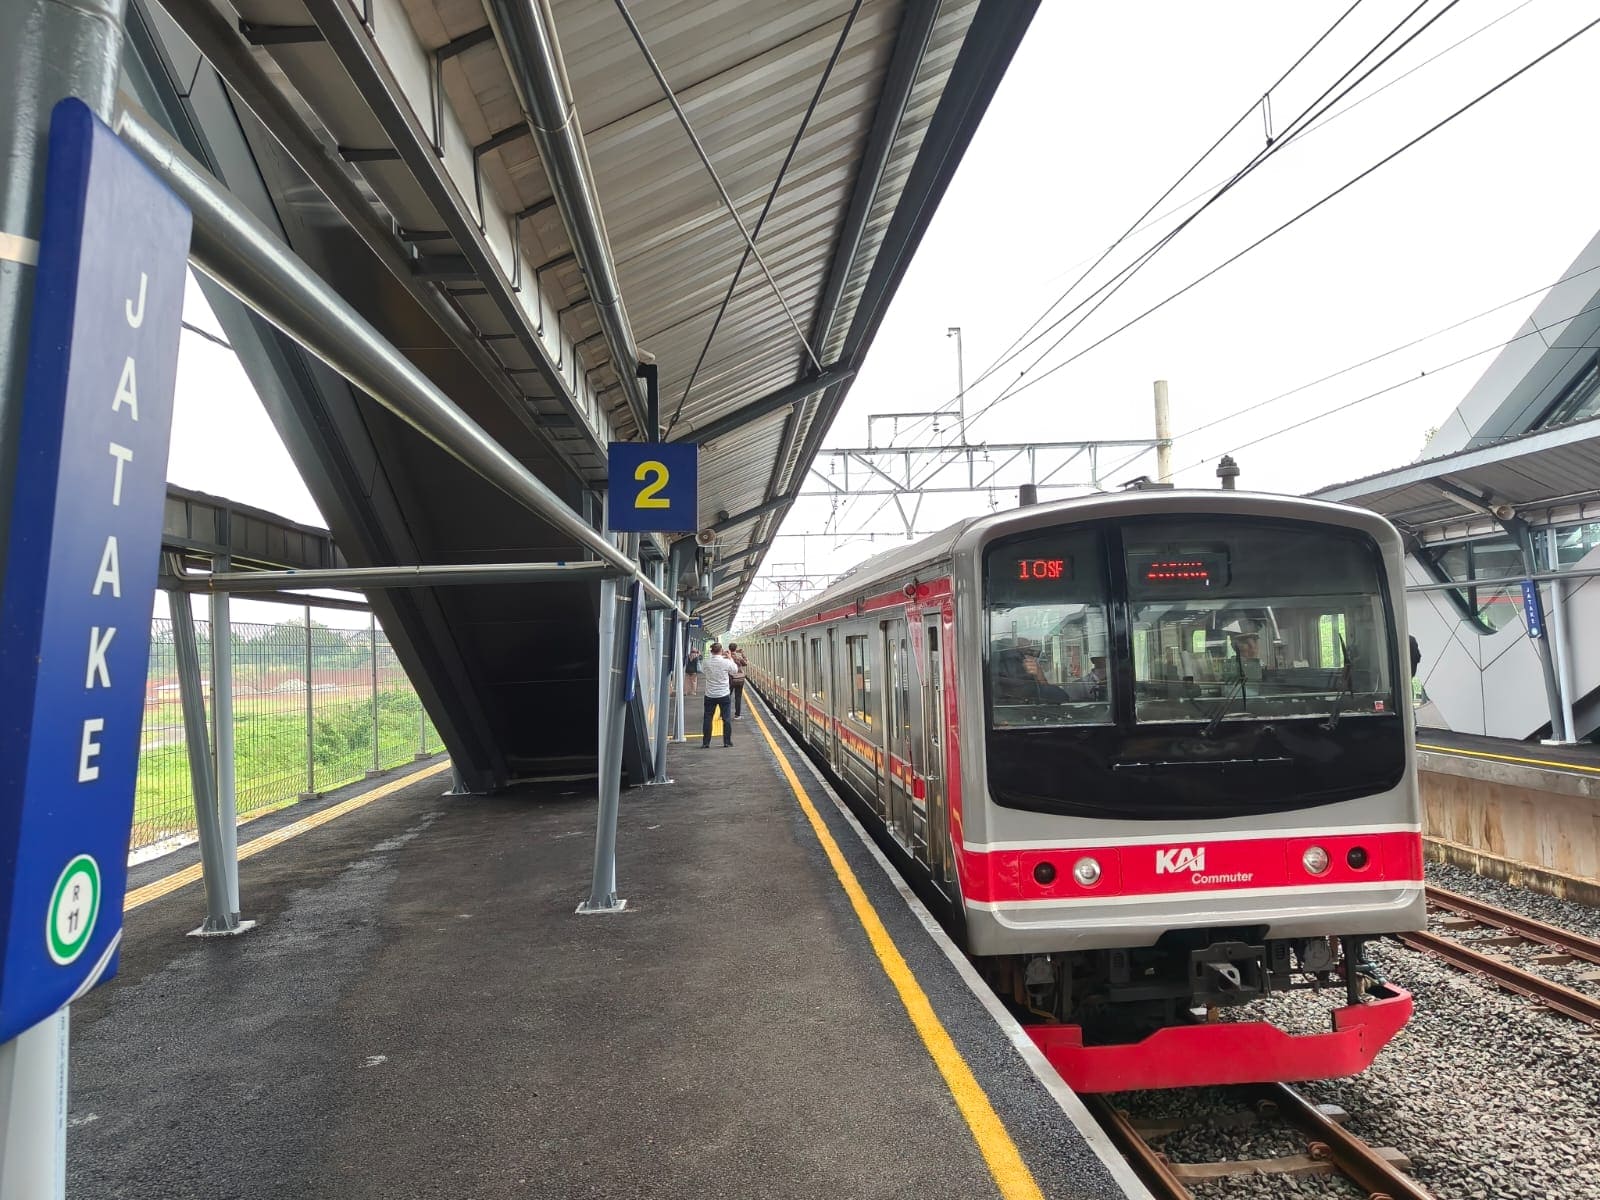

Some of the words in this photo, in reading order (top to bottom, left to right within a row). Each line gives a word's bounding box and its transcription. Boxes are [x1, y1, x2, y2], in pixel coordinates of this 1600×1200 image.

[634, 460, 670, 508] 2
[78, 273, 148, 783] JATAKE
[1155, 847, 1205, 874] KAI
[1191, 872, 1253, 885] Commuter
[72, 885, 80, 902] R
[68, 909, 80, 933] 11
